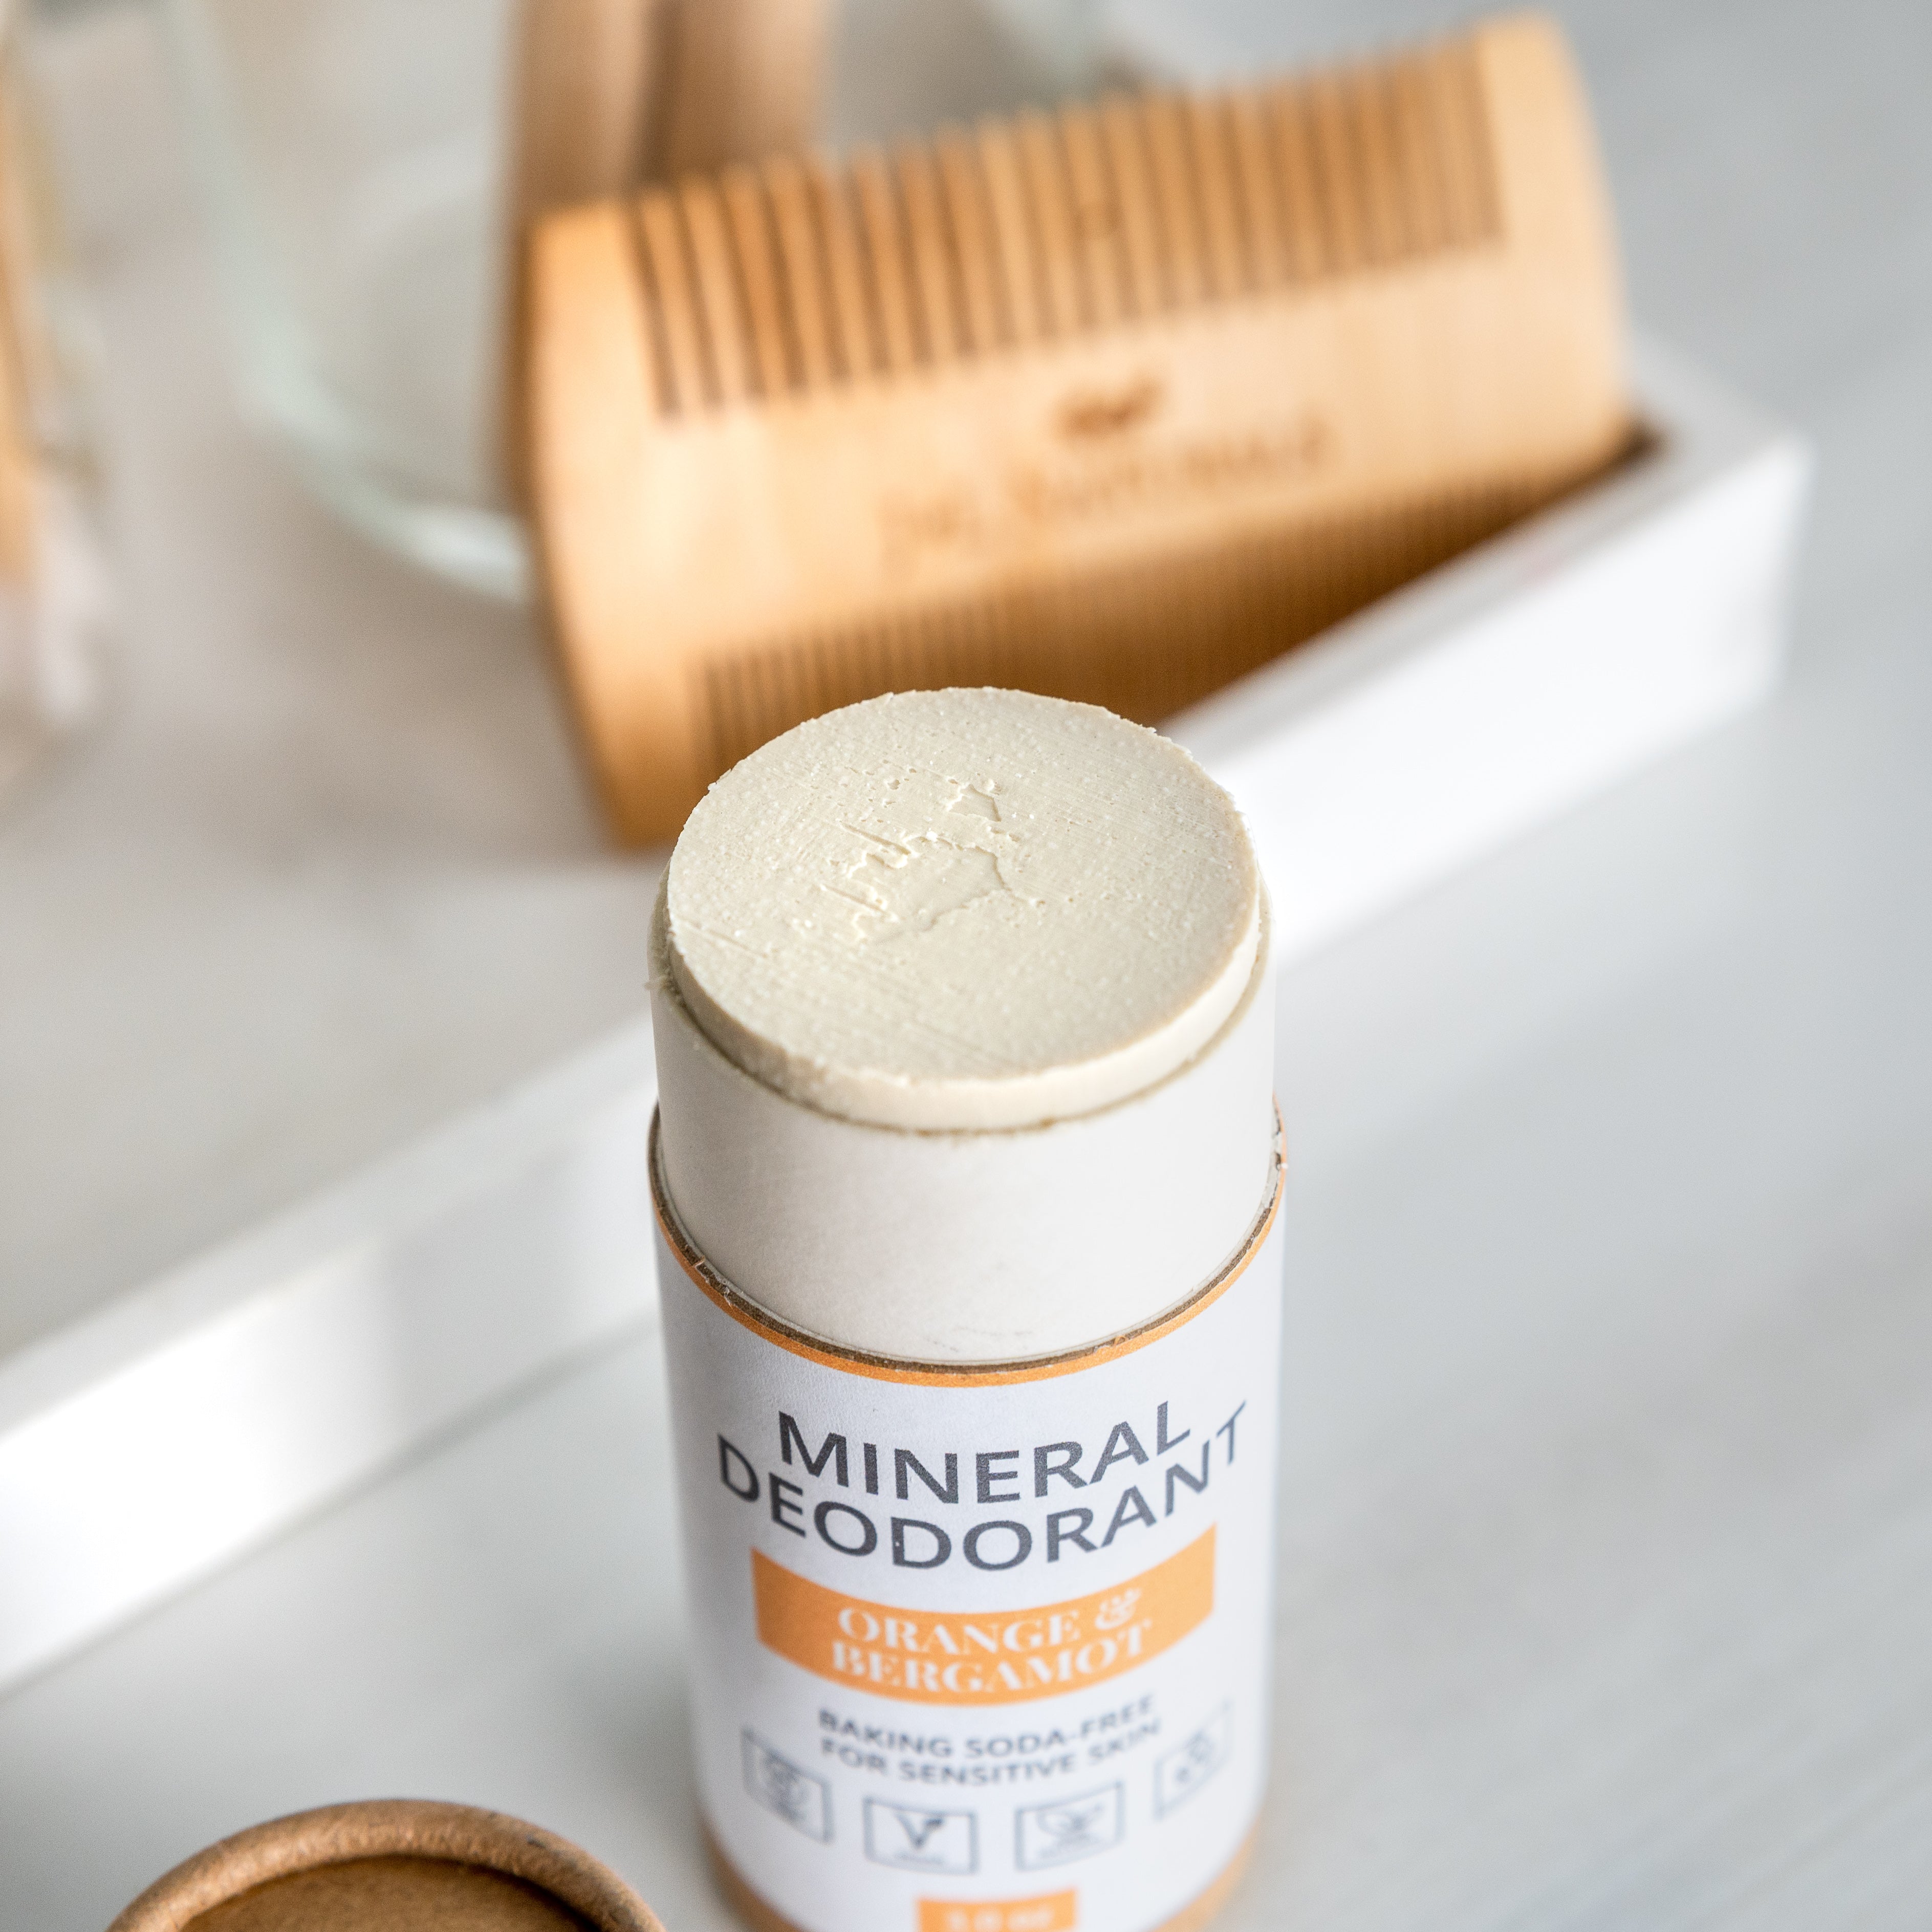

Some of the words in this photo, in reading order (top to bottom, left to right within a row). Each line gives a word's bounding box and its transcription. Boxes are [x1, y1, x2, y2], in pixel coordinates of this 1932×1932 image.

[717, 1400, 1247, 1571] DEODORANT
[778, 1400, 1191, 1505] MINERAL
[832, 1617, 1153, 1692] BERGAMOT
[838, 1608, 1080, 1656] ORANGE
[1094, 1588, 1141, 1630] &
[818, 1708, 953, 1757] BAKING
[965, 1694, 1154, 1758] SODA-FREE
[822, 1740, 888, 1774] FOR
[898, 1753, 1077, 1786] SENSITIVE
[1088, 1718, 1161, 1763] SKIN
